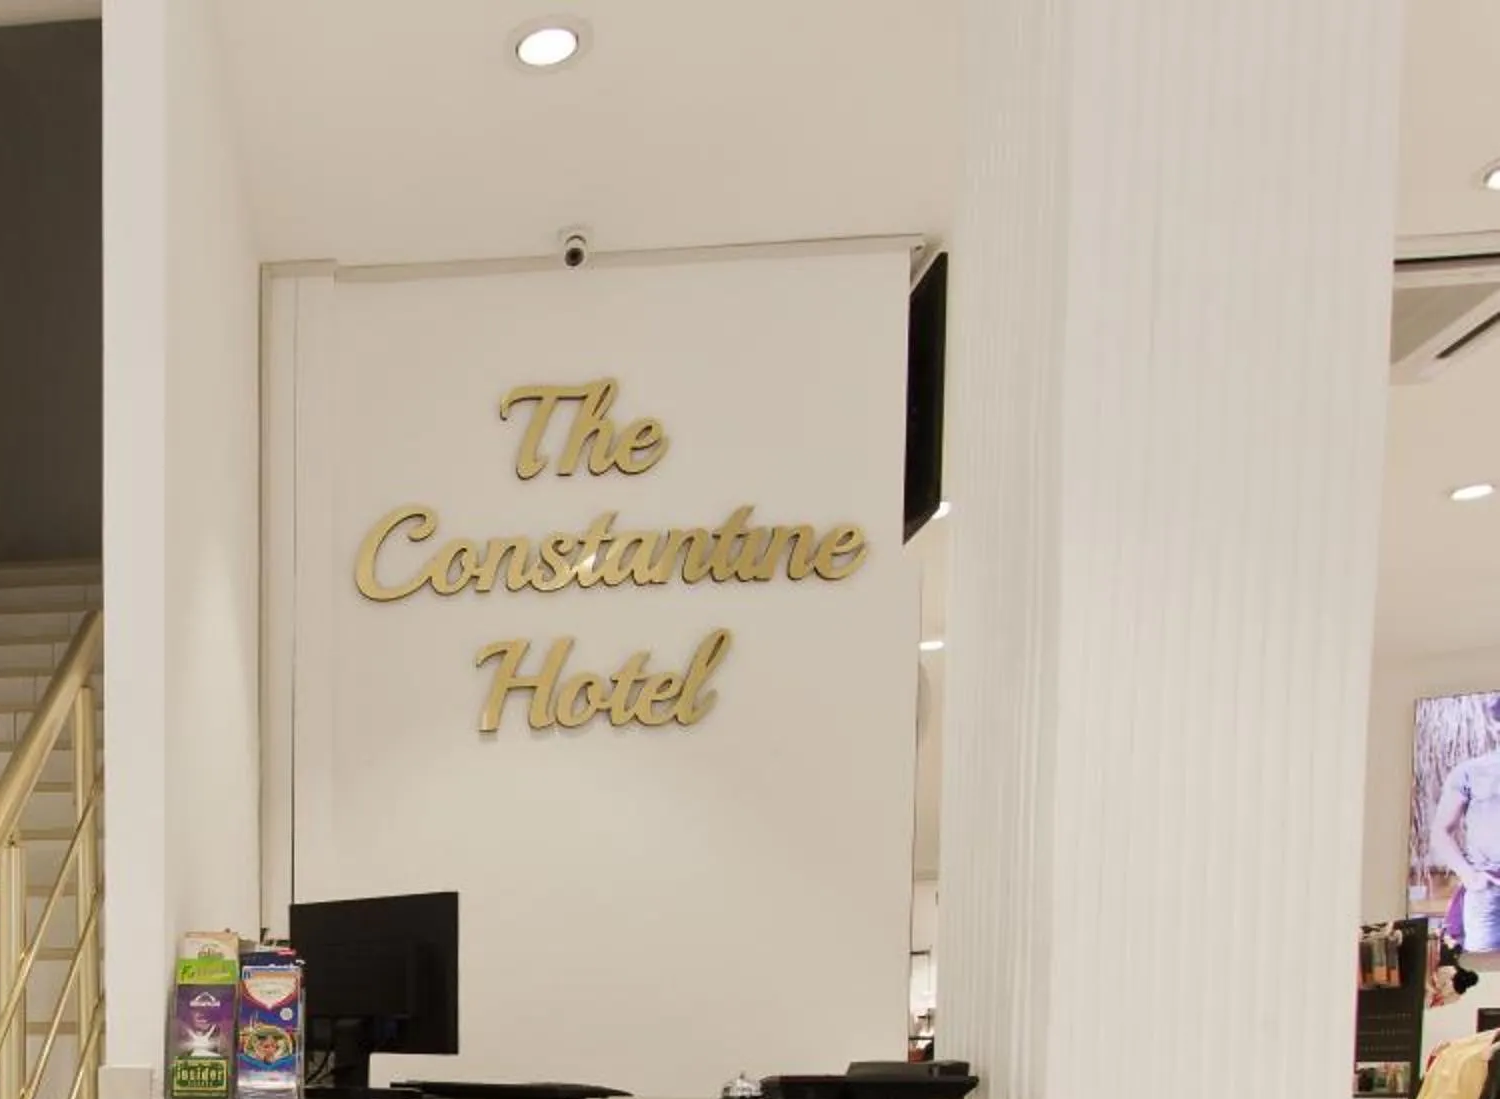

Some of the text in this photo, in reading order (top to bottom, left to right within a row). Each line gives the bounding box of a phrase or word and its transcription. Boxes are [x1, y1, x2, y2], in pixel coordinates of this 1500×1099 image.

[499, 376, 669, 480] The
[354, 504, 868, 602] Constantine
[475, 627, 732, 733] Hotel
